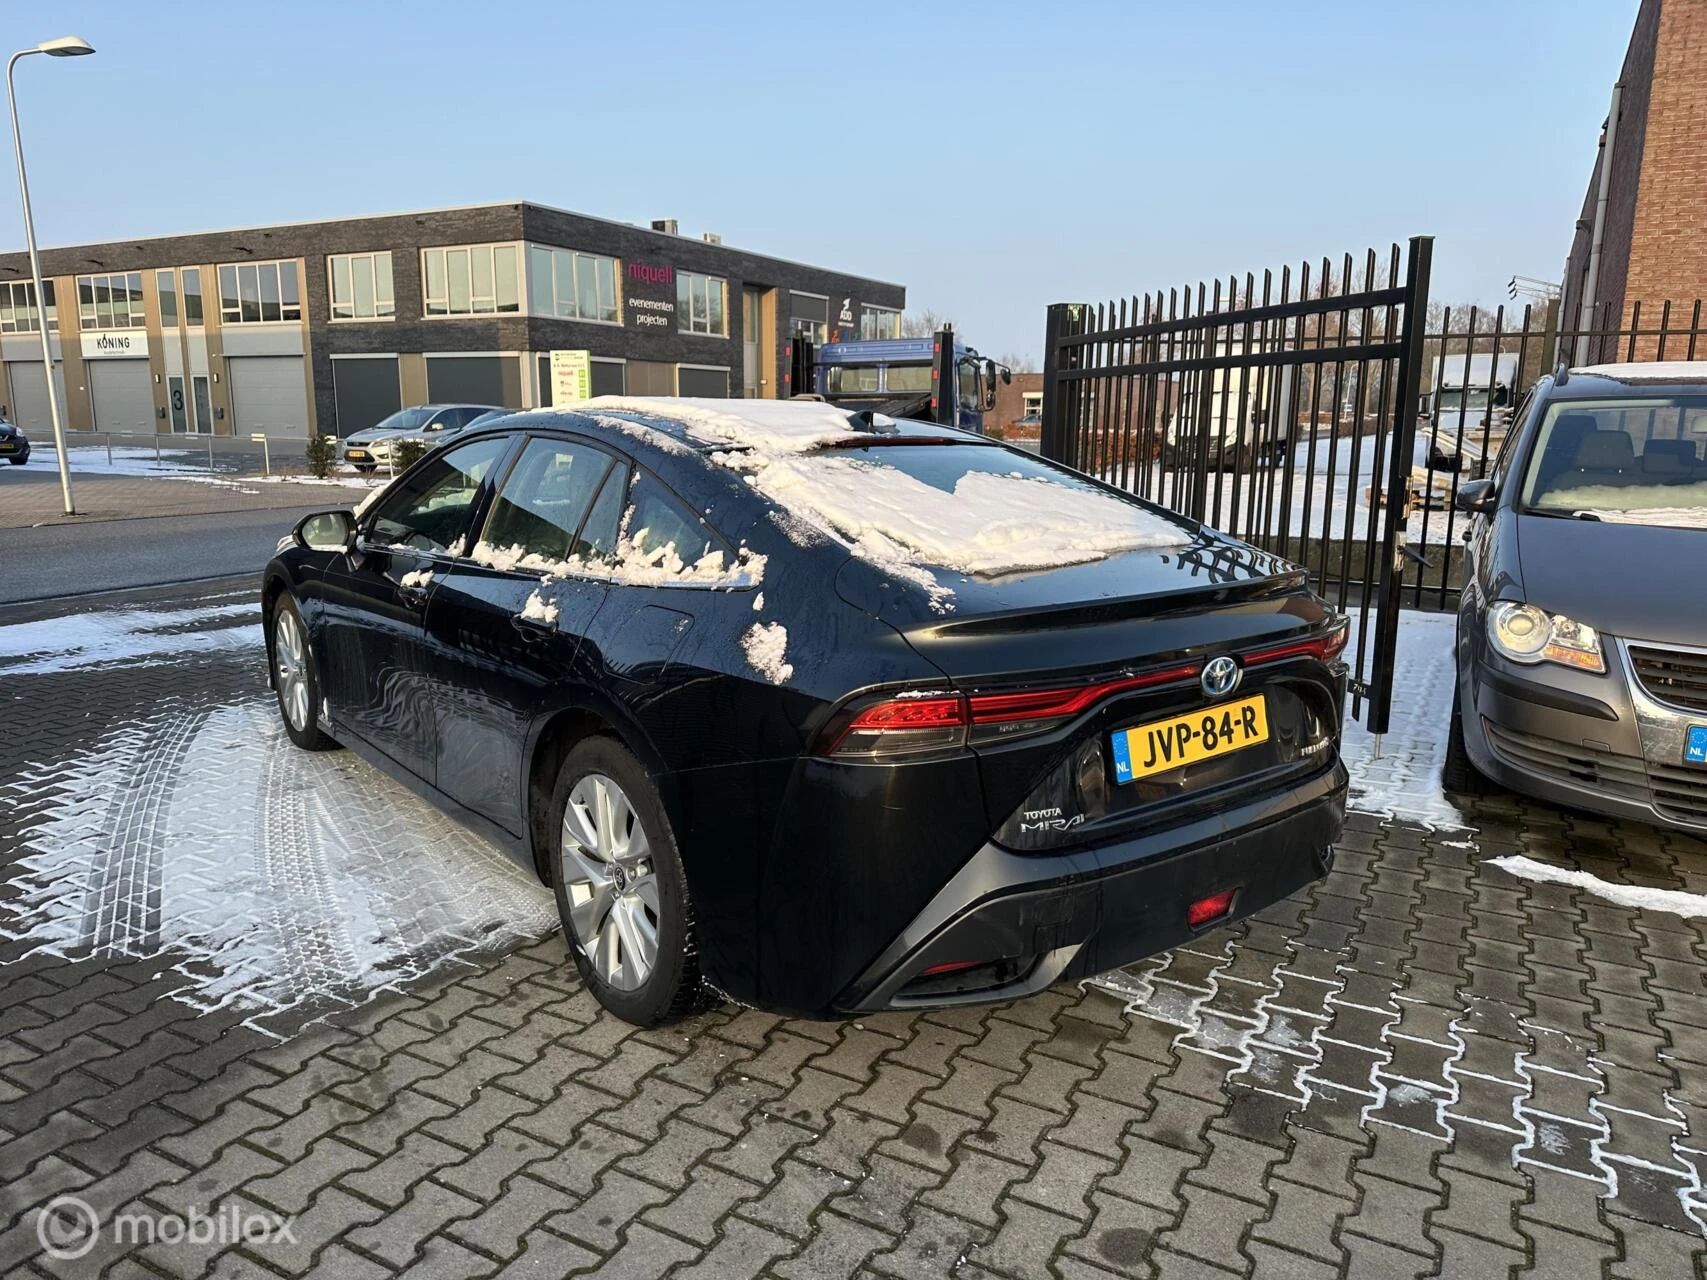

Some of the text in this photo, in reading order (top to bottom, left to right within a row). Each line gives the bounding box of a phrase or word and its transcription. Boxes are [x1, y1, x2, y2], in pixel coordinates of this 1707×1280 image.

[628, 263, 673, 285] niquell
[629, 298, 674, 312] evenementen
[636, 313, 668, 327] projecten
[173, 390, 183, 411] 3
[1116, 762, 1130, 773] NL
[1143, 705, 1259, 768] JVP-84-R
[1690, 746, 1704, 757] NL
[1023, 807, 1062, 820] TOYOTA
[1020, 813, 1085, 832] MIRAI
